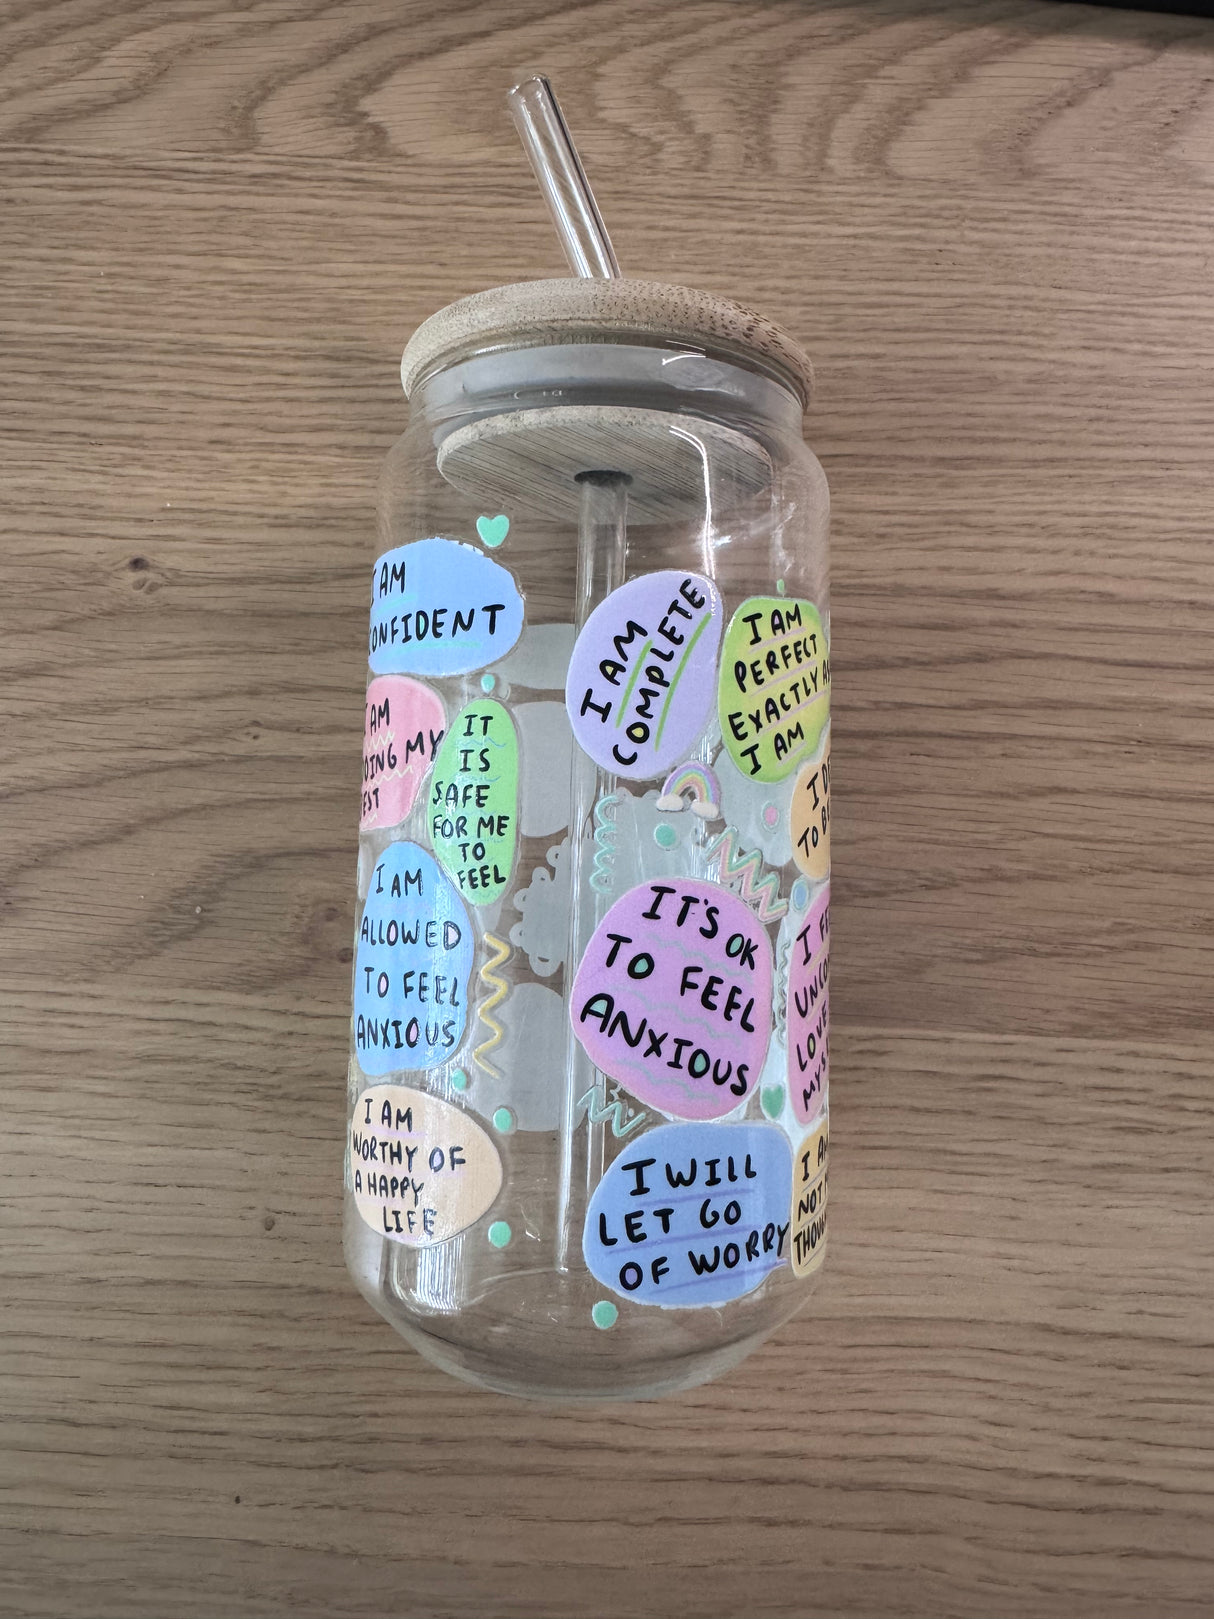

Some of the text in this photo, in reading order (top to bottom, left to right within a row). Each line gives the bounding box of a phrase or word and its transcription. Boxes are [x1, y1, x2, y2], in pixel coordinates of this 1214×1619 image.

[380, 561, 406, 599] AM
[368, 604, 505, 657] ONFIDENT
[742, 603, 802, 646] I AM
[580, 620, 648, 723] I AM
[612, 578, 706, 766] COMPLETE
[734, 633, 818, 693] PERFECT
[370, 697, 390, 736] AM
[728, 666, 818, 741] EXACTLY
[463, 714, 494, 737] IT
[406, 729, 444, 765] MY
[459, 749, 491, 772] IS
[740, 721, 805, 776] I AM
[361, 788, 379, 817] EST
[433, 781, 491, 808] SAFE
[806, 771, 820, 811] I
[433, 815, 510, 839] FOR ME
[797, 826, 819, 858] TO
[458, 842, 486, 862] TO
[375, 863, 424, 898] I AM
[456, 864, 507, 890] FEEL
[361, 916, 462, 950] ALLOWED
[641, 886, 758, 970] IT'S OK
[796, 924, 811, 966] I
[364, 967, 460, 1007] TO FEEL
[606, 933, 755, 1033] TO FEEL
[357, 1014, 456, 1050] ANXIOUS
[580, 993, 750, 1097] ANXIOUS
[796, 1000, 827, 1072] LOVE
[364, 1098, 413, 1132] I AM
[353, 1130, 466, 1173] WORTHY OF
[802, 1150, 810, 1181] I
[355, 1170, 424, 1207] A HAPPY
[621, 1154, 757, 1196] I WILL
[383, 1206, 438, 1236] LIFE
[798, 1181, 823, 1222] NOT
[599, 1199, 742, 1246] LET GO
[619, 1222, 790, 1290] OF WORRY
